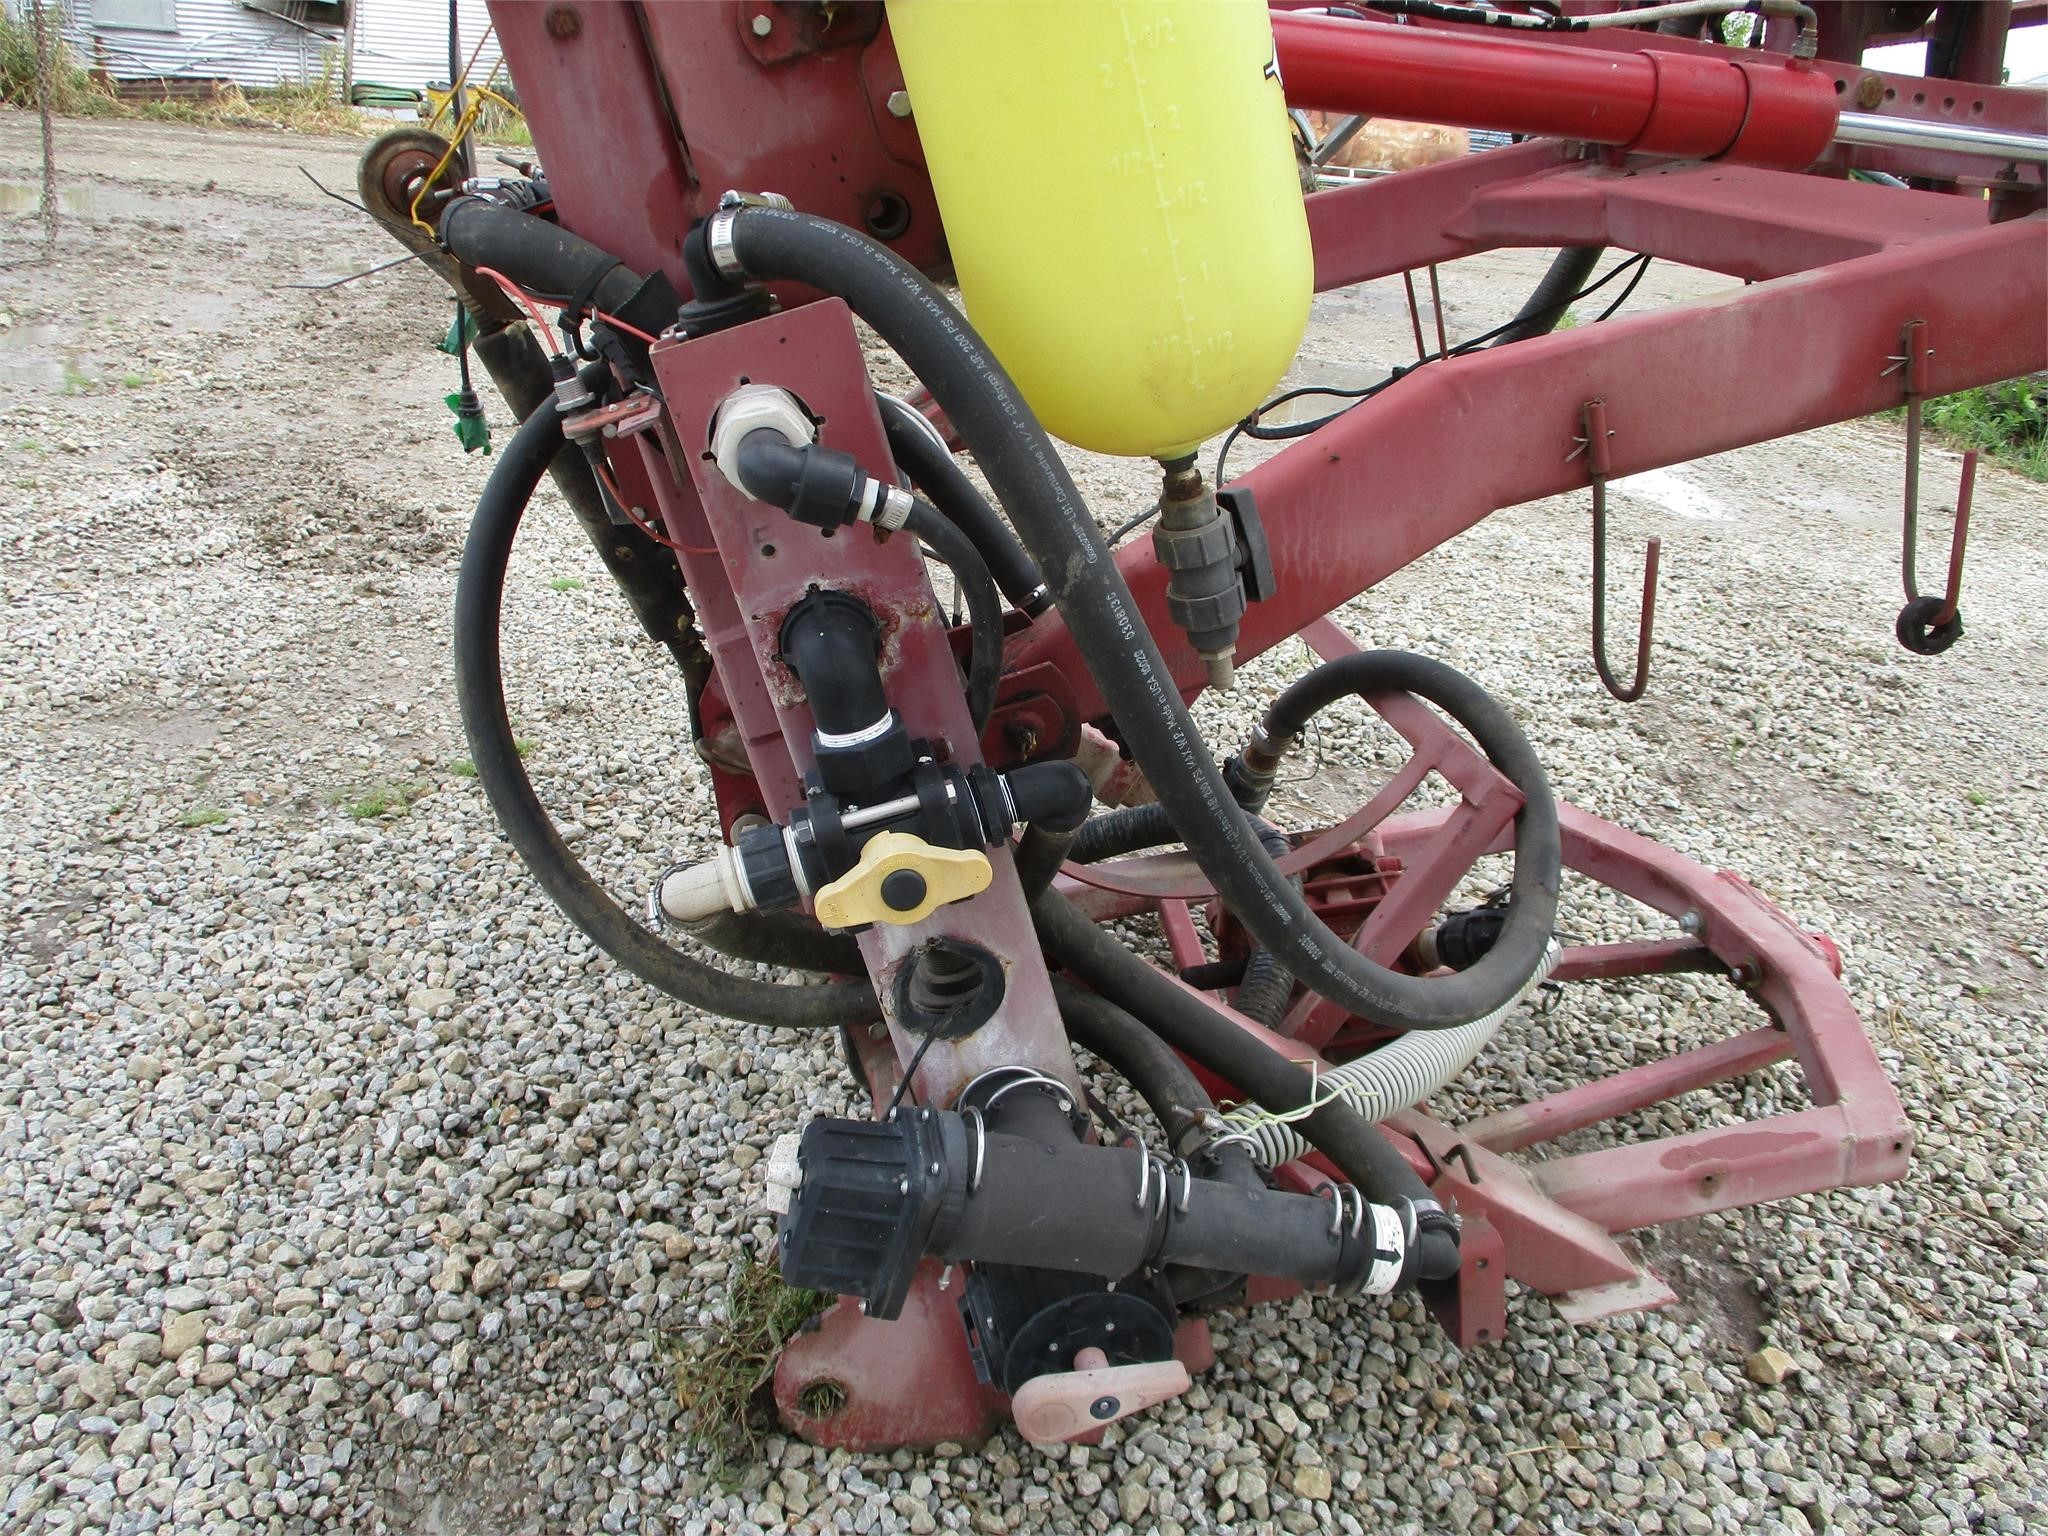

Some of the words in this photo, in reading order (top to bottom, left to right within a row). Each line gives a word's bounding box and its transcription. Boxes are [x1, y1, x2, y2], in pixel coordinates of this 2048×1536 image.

[1100, 63, 1115, 88] 2
[1168, 104, 1181, 129] 2
[874, 252, 900, 275] Made
[920, 294, 943, 317] MAX
[940, 316, 958, 334] PSI
[954, 333, 974, 353] 200
[1146, 674, 1162, 696] USA
[1157, 694, 1168, 707] in
[1161, 704, 1178, 730] Made
